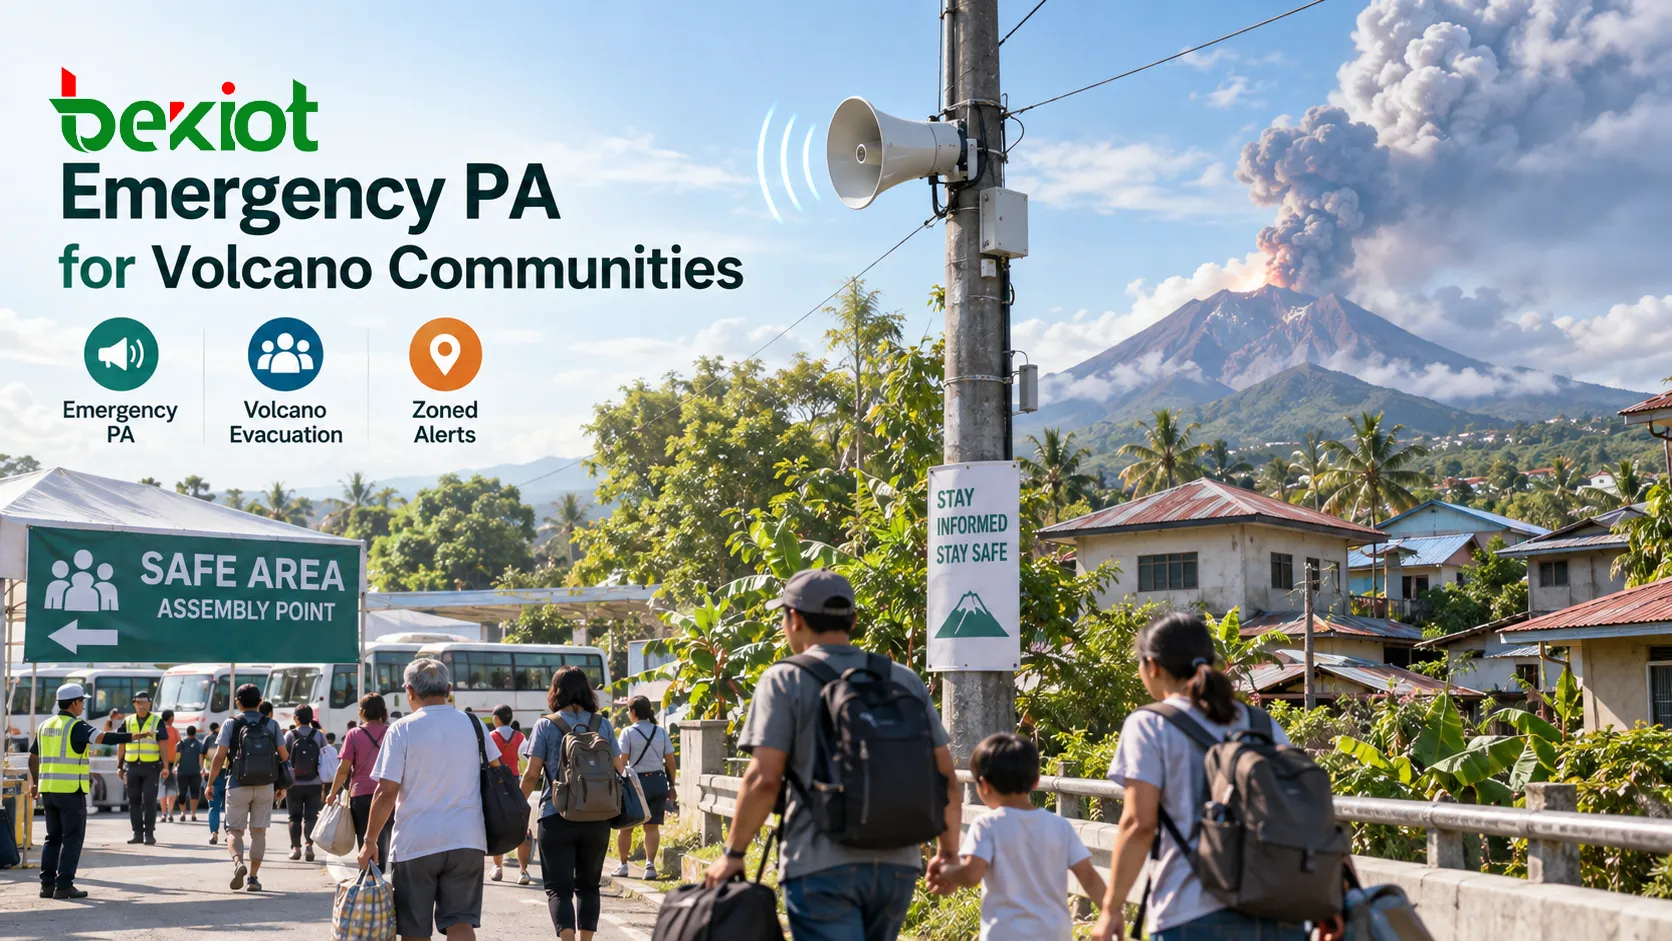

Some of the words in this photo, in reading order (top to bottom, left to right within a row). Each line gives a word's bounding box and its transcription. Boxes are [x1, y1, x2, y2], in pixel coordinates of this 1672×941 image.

[937, 487, 975, 509] STAY
[937, 513, 1008, 536] INFORMED
[936, 543, 969, 565] STAY
[971, 542, 1008, 563] SAFE
[140, 550, 237, 588] SAFE
[247, 556, 346, 592] AREA
[157, 598, 270, 621] ASSEMBLY
[276, 601, 336, 622] POINT
